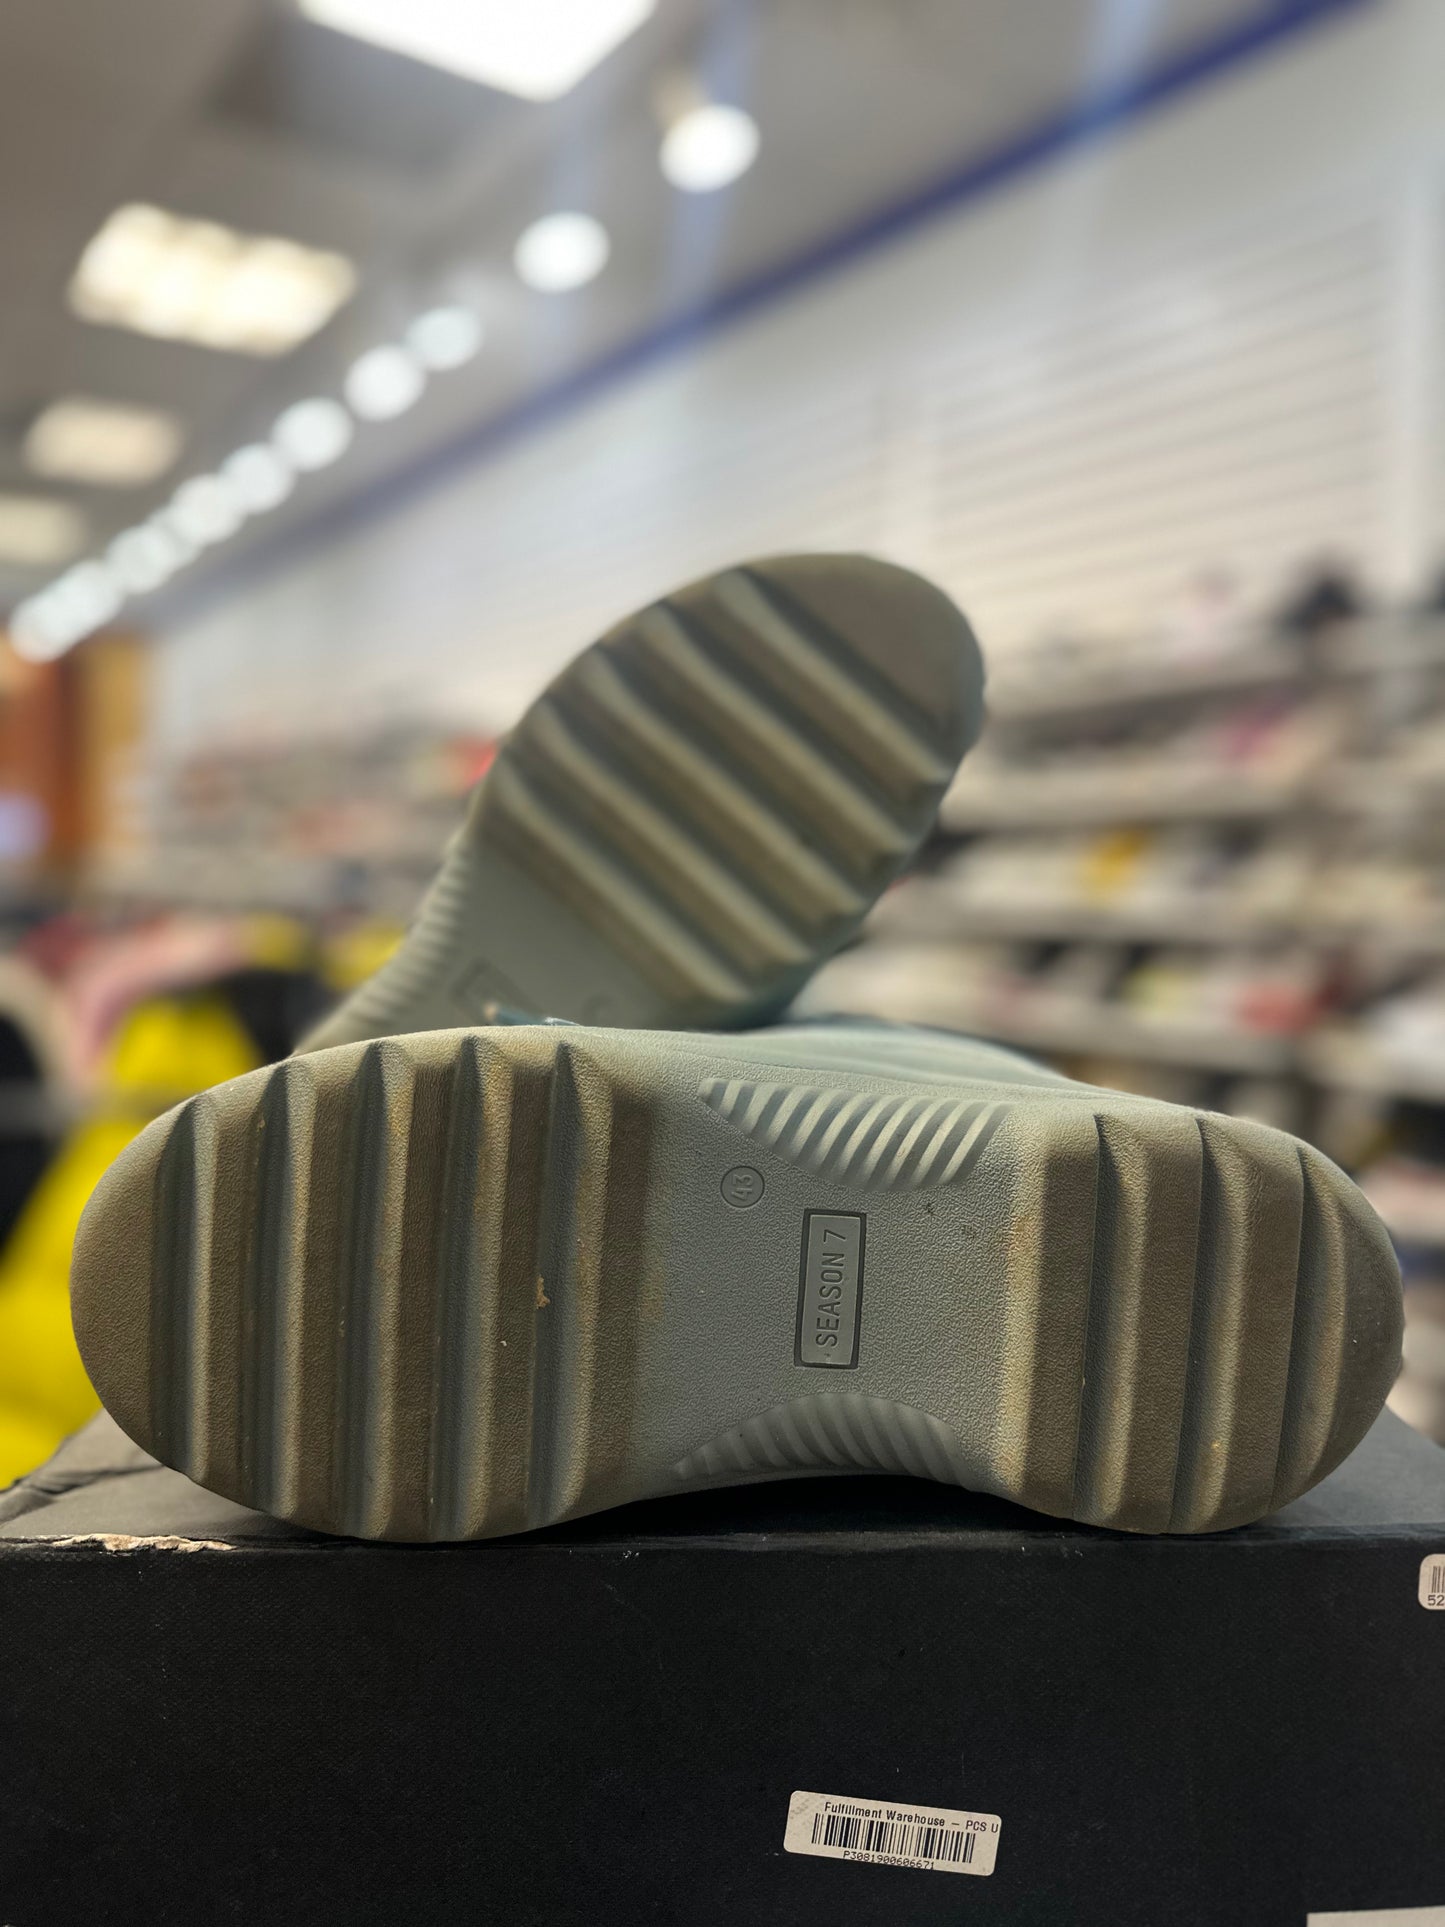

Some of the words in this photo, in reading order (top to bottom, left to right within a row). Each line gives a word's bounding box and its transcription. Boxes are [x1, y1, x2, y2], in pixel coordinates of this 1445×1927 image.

[731, 1174, 753, 1200] 43
[824, 1229, 846, 1242] 7
[816, 1252, 845, 1347] SEASON
[824, 1802, 882, 1819] Fulfillment
[886, 1809, 945, 1827] Warehouse
[965, 1820, 987, 1832] PCS
[991, 1823, 999, 1833] U
[843, 1850, 934, 1870] P3081900606671
